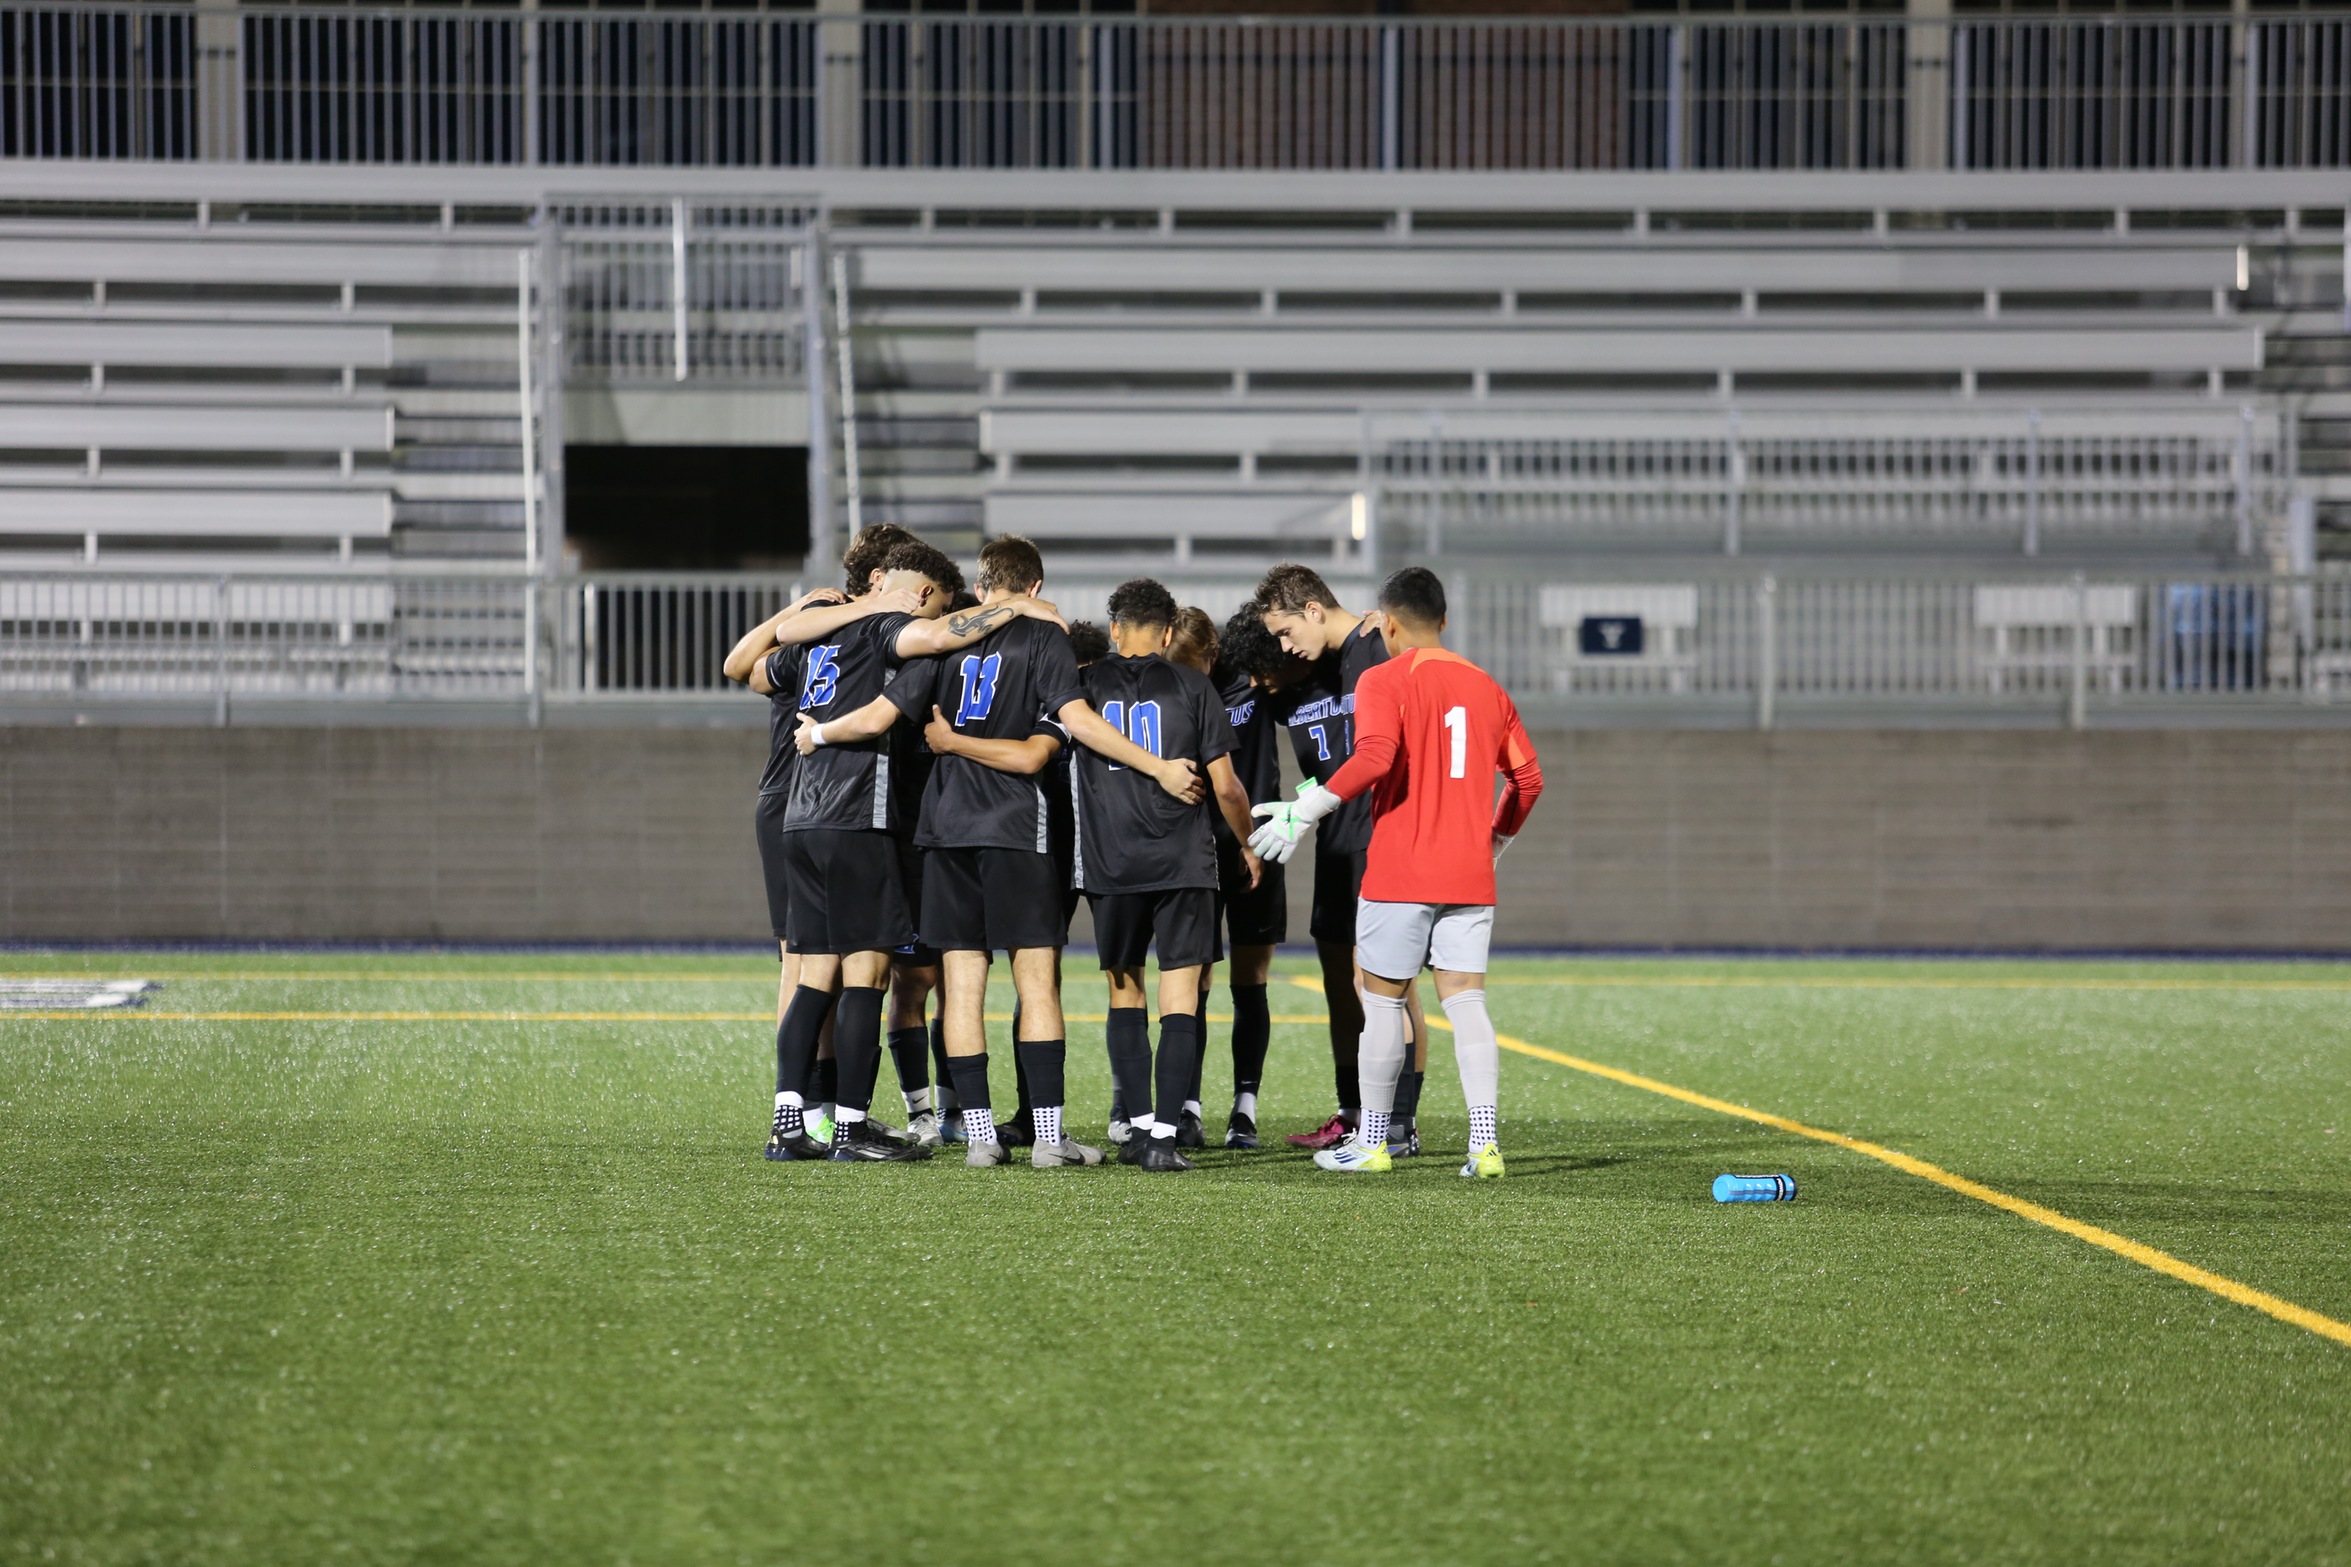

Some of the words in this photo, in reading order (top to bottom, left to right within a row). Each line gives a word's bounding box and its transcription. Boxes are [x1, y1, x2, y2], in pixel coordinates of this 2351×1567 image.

[799, 644, 841, 711] 15
[1102, 700, 1162, 771] 10
[1308, 724, 1331, 761] 7
[1444, 705, 1467, 779] 1
